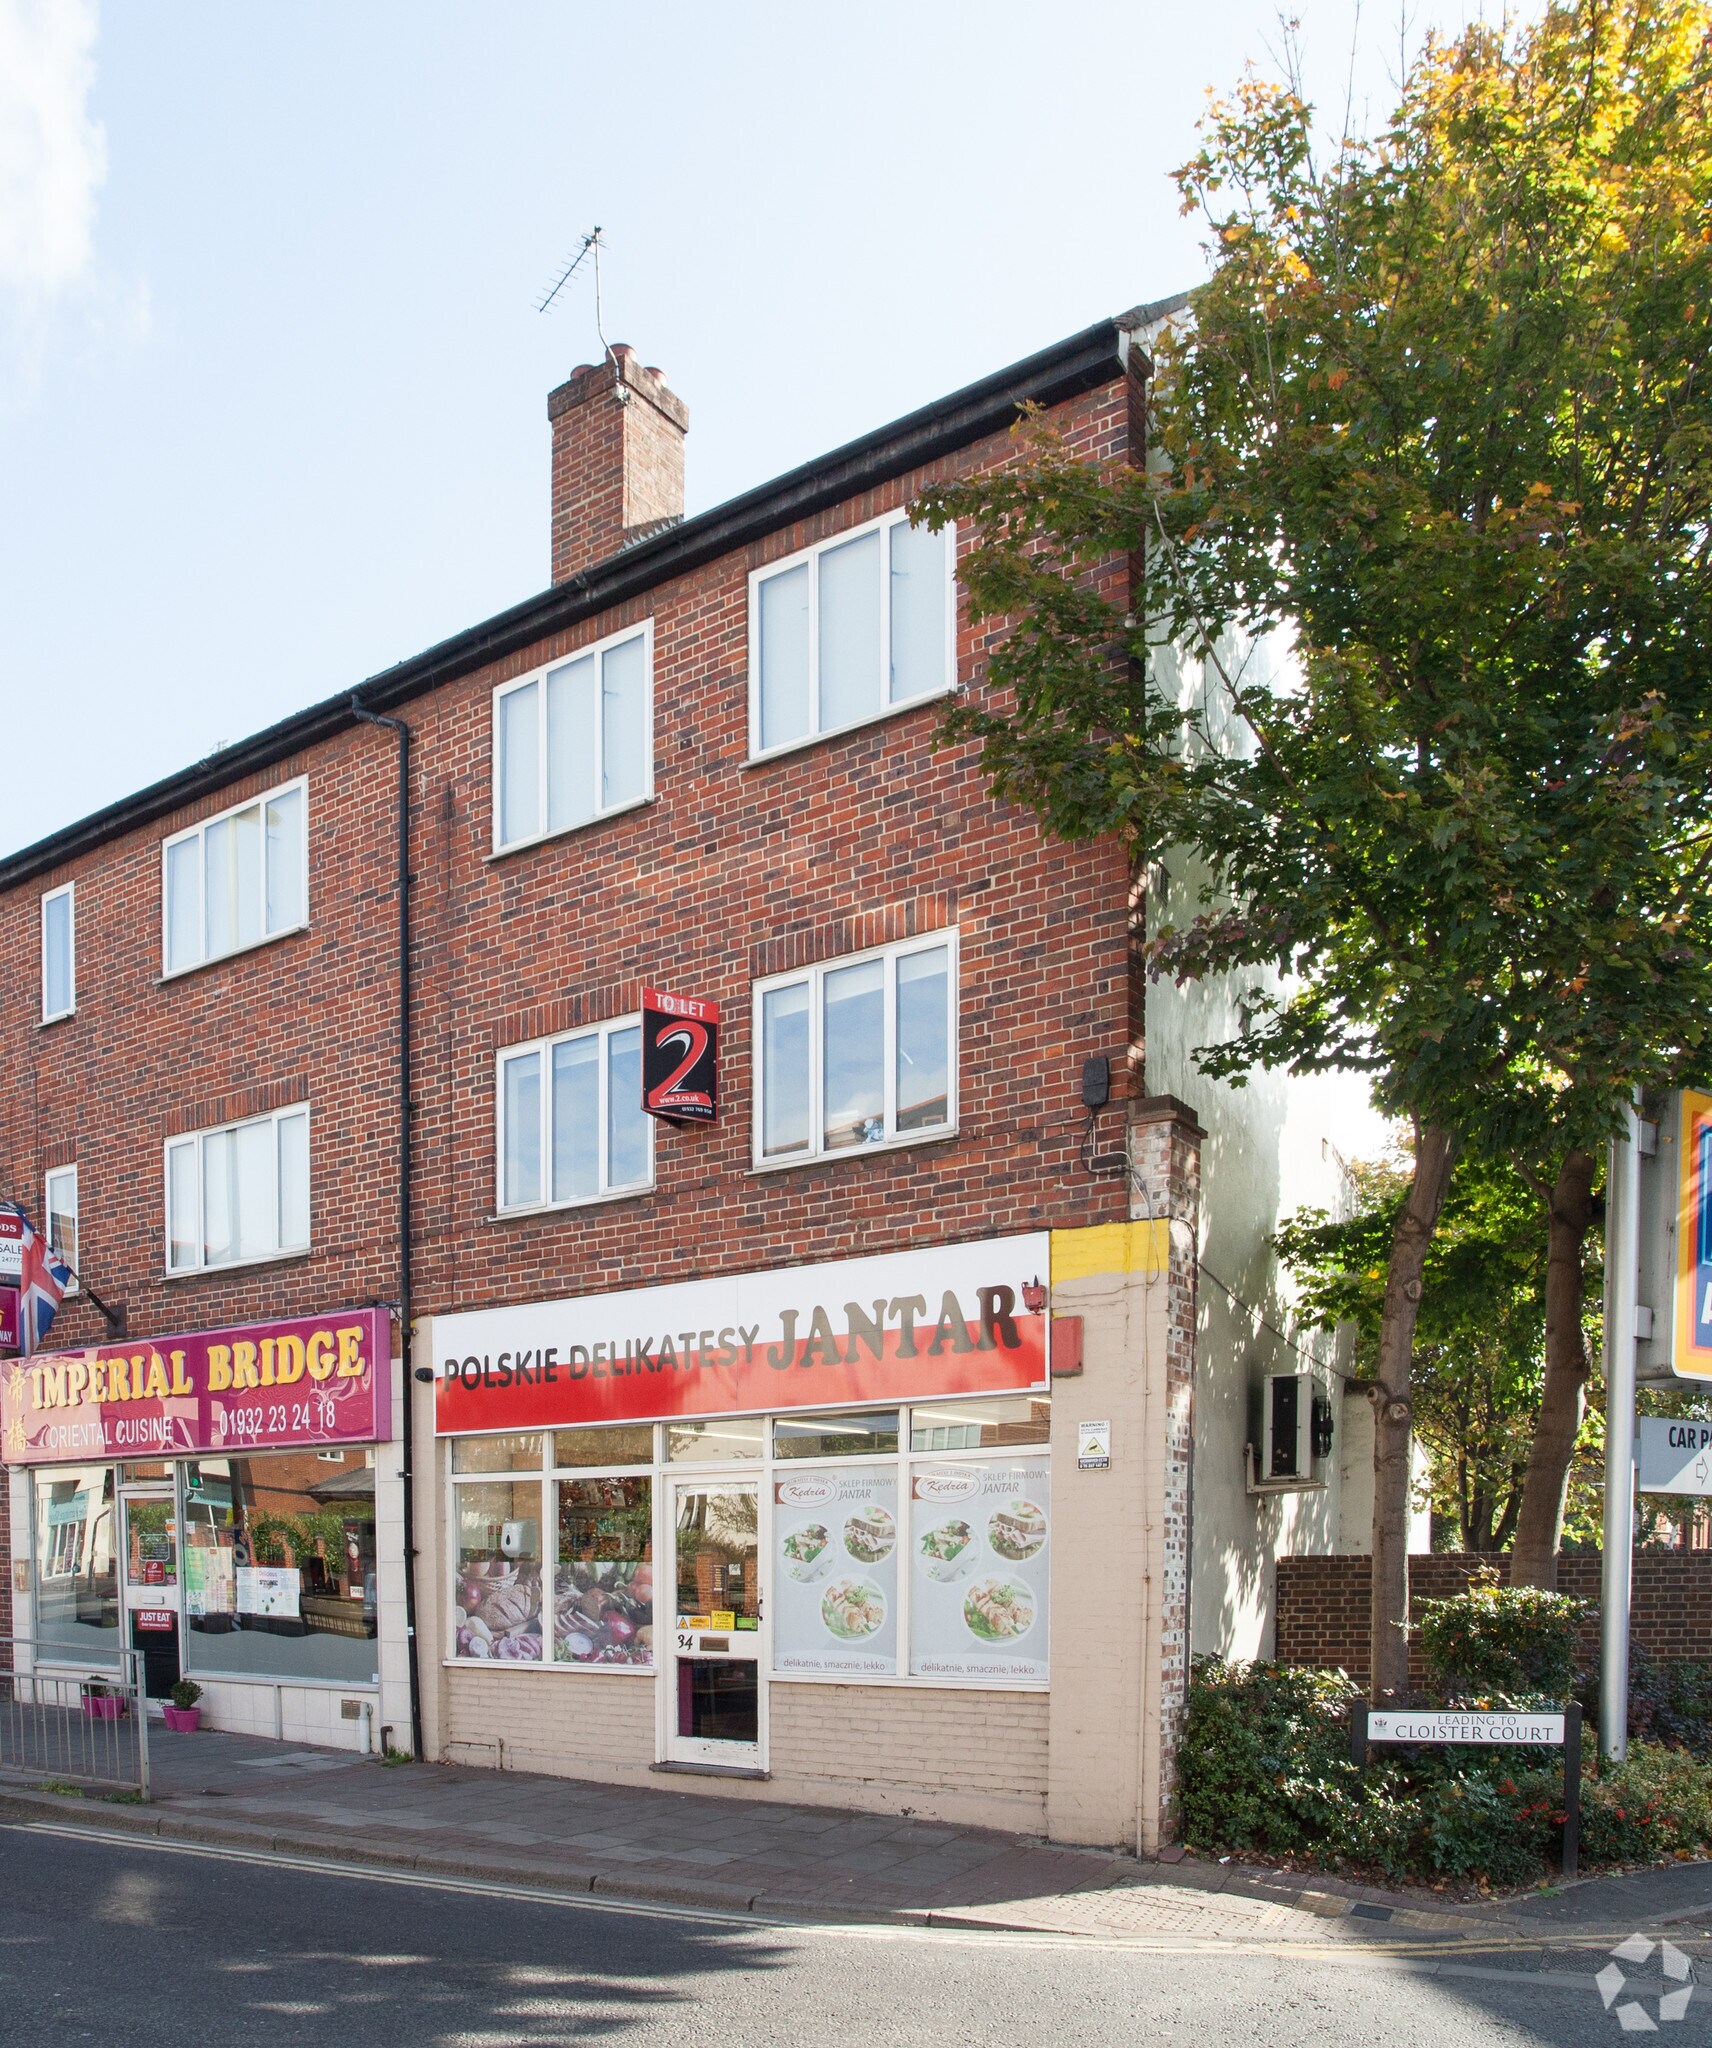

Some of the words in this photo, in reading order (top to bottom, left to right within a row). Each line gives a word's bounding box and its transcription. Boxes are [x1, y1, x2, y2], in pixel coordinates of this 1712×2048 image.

[655, 993, 675, 1011] TO
[680, 999, 706, 1017] LET
[648, 1020, 713, 1108] 2
[659, 1094, 700, 1104] www.2.co.uk
[0, 1223, 17, 1232] DS
[444, 1347, 558, 1392] POLSKIE
[569, 1323, 760, 1380] DELIKATESY
[767, 1285, 1022, 1371] JANTAR
[31, 1351, 194, 1410] IMPERIAL
[207, 1325, 365, 1391] BRIDGE
[219, 1407, 263, 1436] 01932
[268, 1405, 287, 1432] 23
[292, 1403, 310, 1431] 24
[318, 1401, 336, 1430] 18
[50, 1421, 112, 1449] ORIENTAL
[116, 1416, 174, 1444] CUISINE
[1668, 1426, 1697, 1449] CAR
[983, 1472, 1007, 1481] SKLEP
[1009, 1470, 1048, 1480] FIRMOWY
[839, 1480, 861, 1488] SKLEP
[862, 1478, 897, 1487] FIRMOWY
[981, 1482, 1019, 1495] JANTAR
[838, 1489, 871, 1501] JANTAR
[140, 1611, 156, 1621] JUST
[157, 1612, 170, 1622] EAT
[678, 1634, 693, 1650] 34
[783, 1658, 822, 1669] delikatnie,
[824, 1661, 862, 1670] smacznie,
[863, 1661, 885, 1670] lekko
[920, 1663, 964, 1673] delikatnie,
[966, 1665, 1009, 1675] smacznie,
[1010, 1665, 1035, 1674] lekko
[1437, 1715, 1495, 1725] LEADING
[1499, 1716, 1517, 1726] TO
[1395, 1725, 1483, 1739] CLOISTER
[1489, 1727, 1554, 1740] COURT
